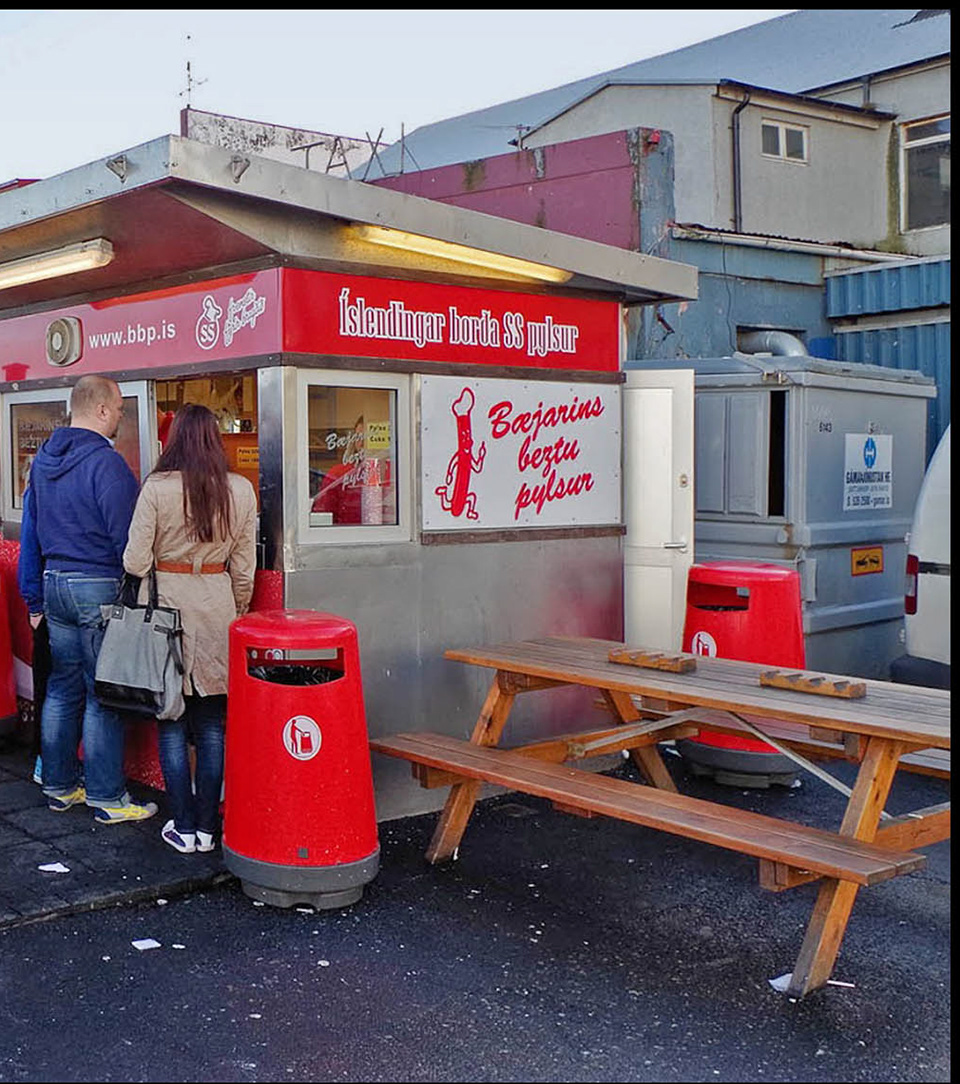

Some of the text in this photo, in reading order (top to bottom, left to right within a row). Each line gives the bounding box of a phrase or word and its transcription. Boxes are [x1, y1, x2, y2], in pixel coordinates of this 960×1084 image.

[89, 319, 176, 349] www.bbp.is
[200, 322, 216, 343] SS
[339, 287, 580, 357] Íslendingar borða SS pylsur
[488, 396, 605, 441] Bæjarins
[518, 435, 580, 478] beztu
[515, 469, 594, 521] pylsur
